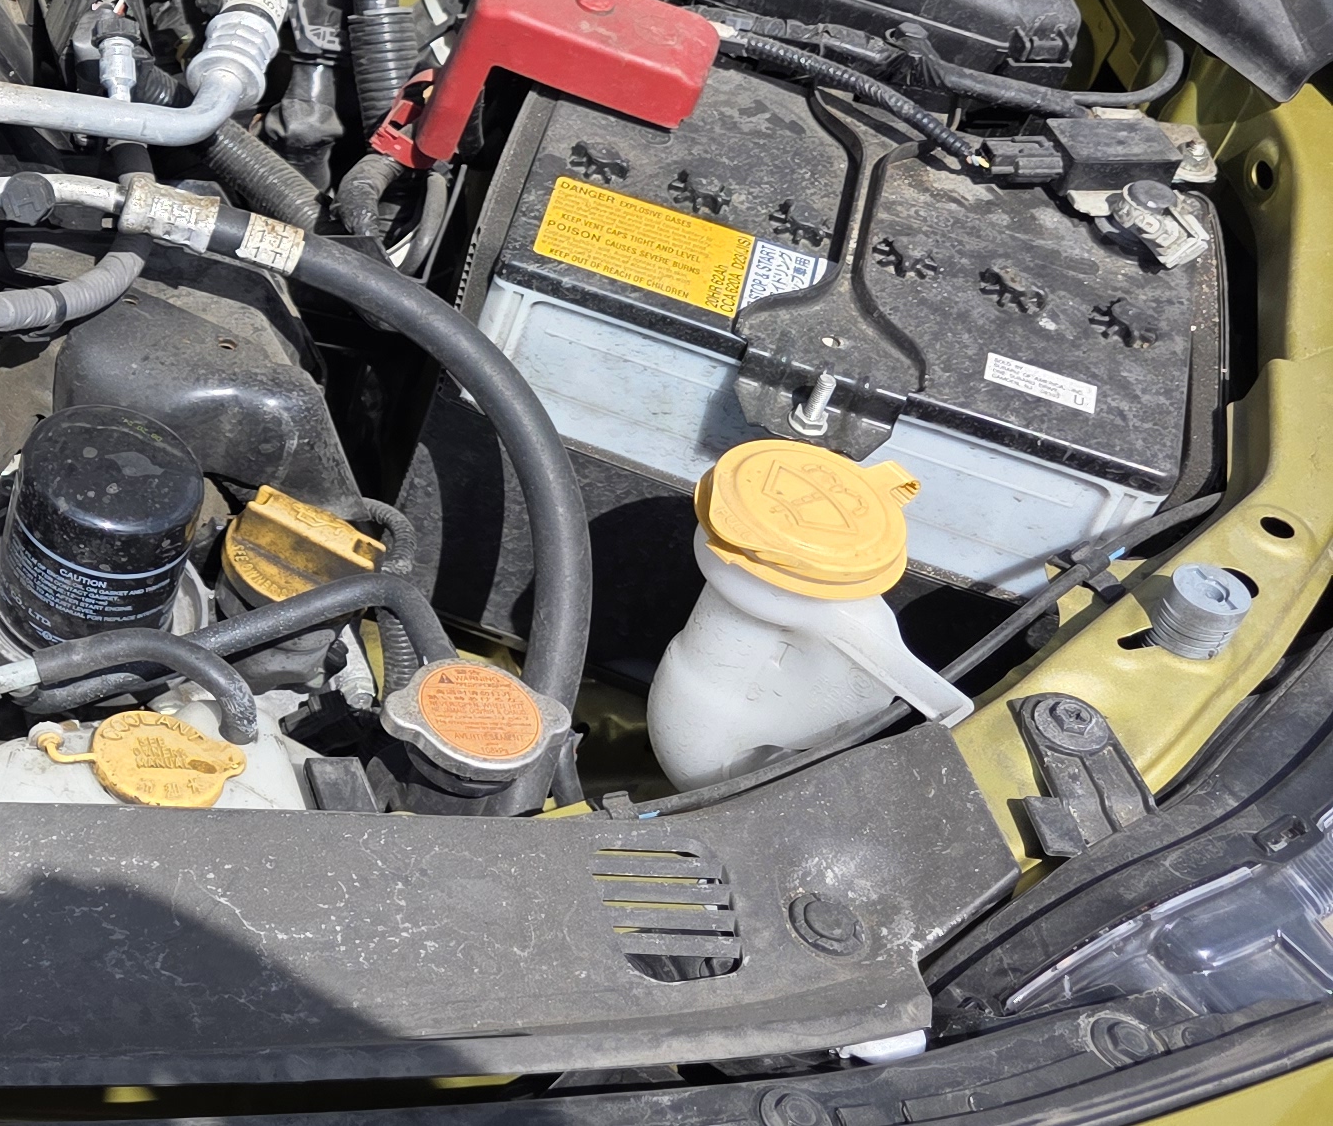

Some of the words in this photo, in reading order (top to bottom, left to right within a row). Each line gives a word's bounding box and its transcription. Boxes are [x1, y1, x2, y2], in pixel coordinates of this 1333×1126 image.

[560, 181, 616, 204] DANGER
[619, 200, 663, 220] EXPLOSIVE
[665, 214, 692, 229] GASES
[561, 212, 582, 224] KEEP
[583, 220, 605, 234] VENT
[606, 227, 628, 240] CAPS
[630, 234, 655, 249] TIGHT
[656, 243, 675, 255] AND
[676, 249, 702, 264] LEVEL
[547, 219, 602, 243] POISON
[605, 239, 638, 256] CAUSES
[639, 250, 671, 266] SEVERE
[672, 260, 701, 276] BURNS
[756, 244, 776, 272] START
[549, 247, 570, 259] KEEP
[571, 255, 589, 266] OUT
[591, 261, 602, 270] OF
[603, 265, 632, 281] REACH
[633, 275, 645, 285] OF
[646, 279, 690, 299] CHILDREN
[748, 278, 769, 300] STOP
[1073, 394, 1085, 406] U
[233, 544, 249, 562] SEE
[60, 568, 107, 589] CAUTION
[53, 579, 88, 597] CONTACT
[85, 586, 98, 594] ON
[98, 588, 129, 596] GASKET
[128, 588, 145, 596] AND
[44, 592, 72, 608] ADJUST
[79, 601, 104, 611] START
[55, 604, 86, 619] MANUAL
[86, 614, 103, 622] FOR
[100, 713, 205, 741] COOLANT
[136, 736, 166, 747] SEE
[135, 757, 194, 770] MANUAL
